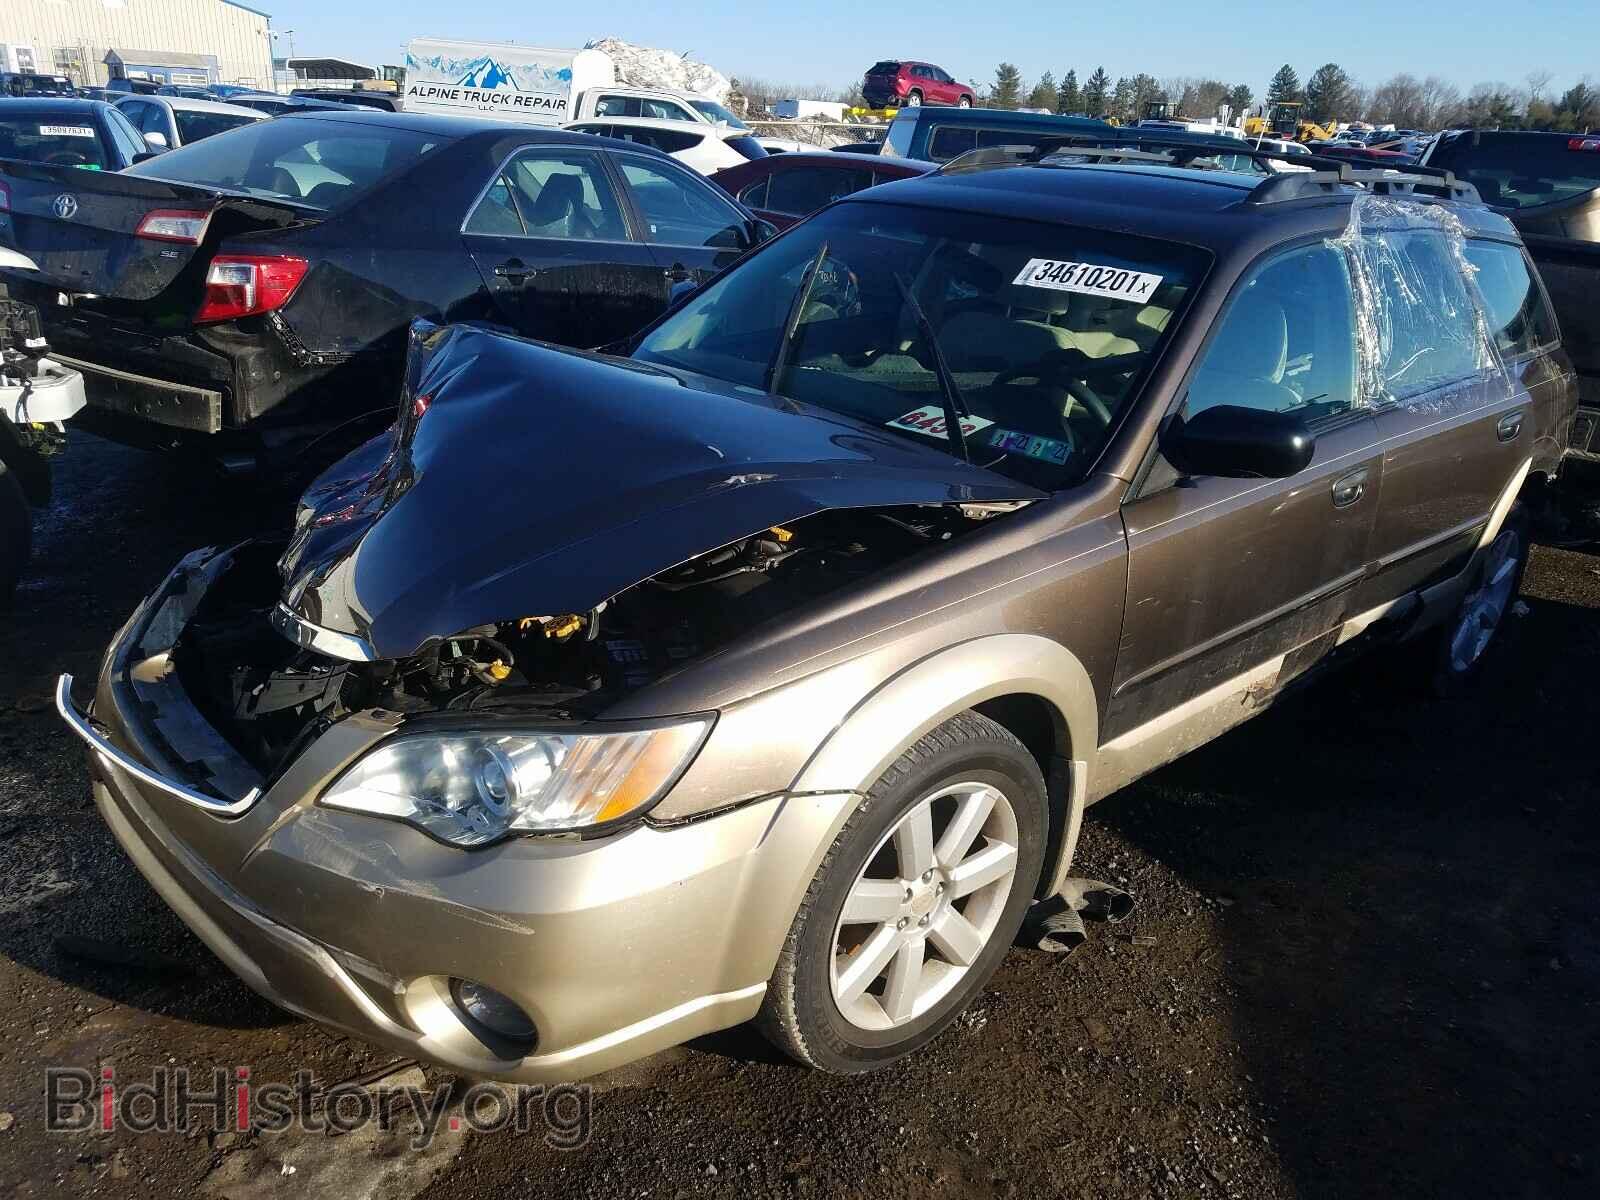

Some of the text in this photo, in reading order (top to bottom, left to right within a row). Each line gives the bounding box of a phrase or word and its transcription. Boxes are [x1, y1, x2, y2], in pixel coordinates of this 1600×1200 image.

[408, 86, 567, 110] ALPINE TRUCK REPAIR
[160, 250, 179, 258] SE
[1034, 261, 1142, 294] 34610201
